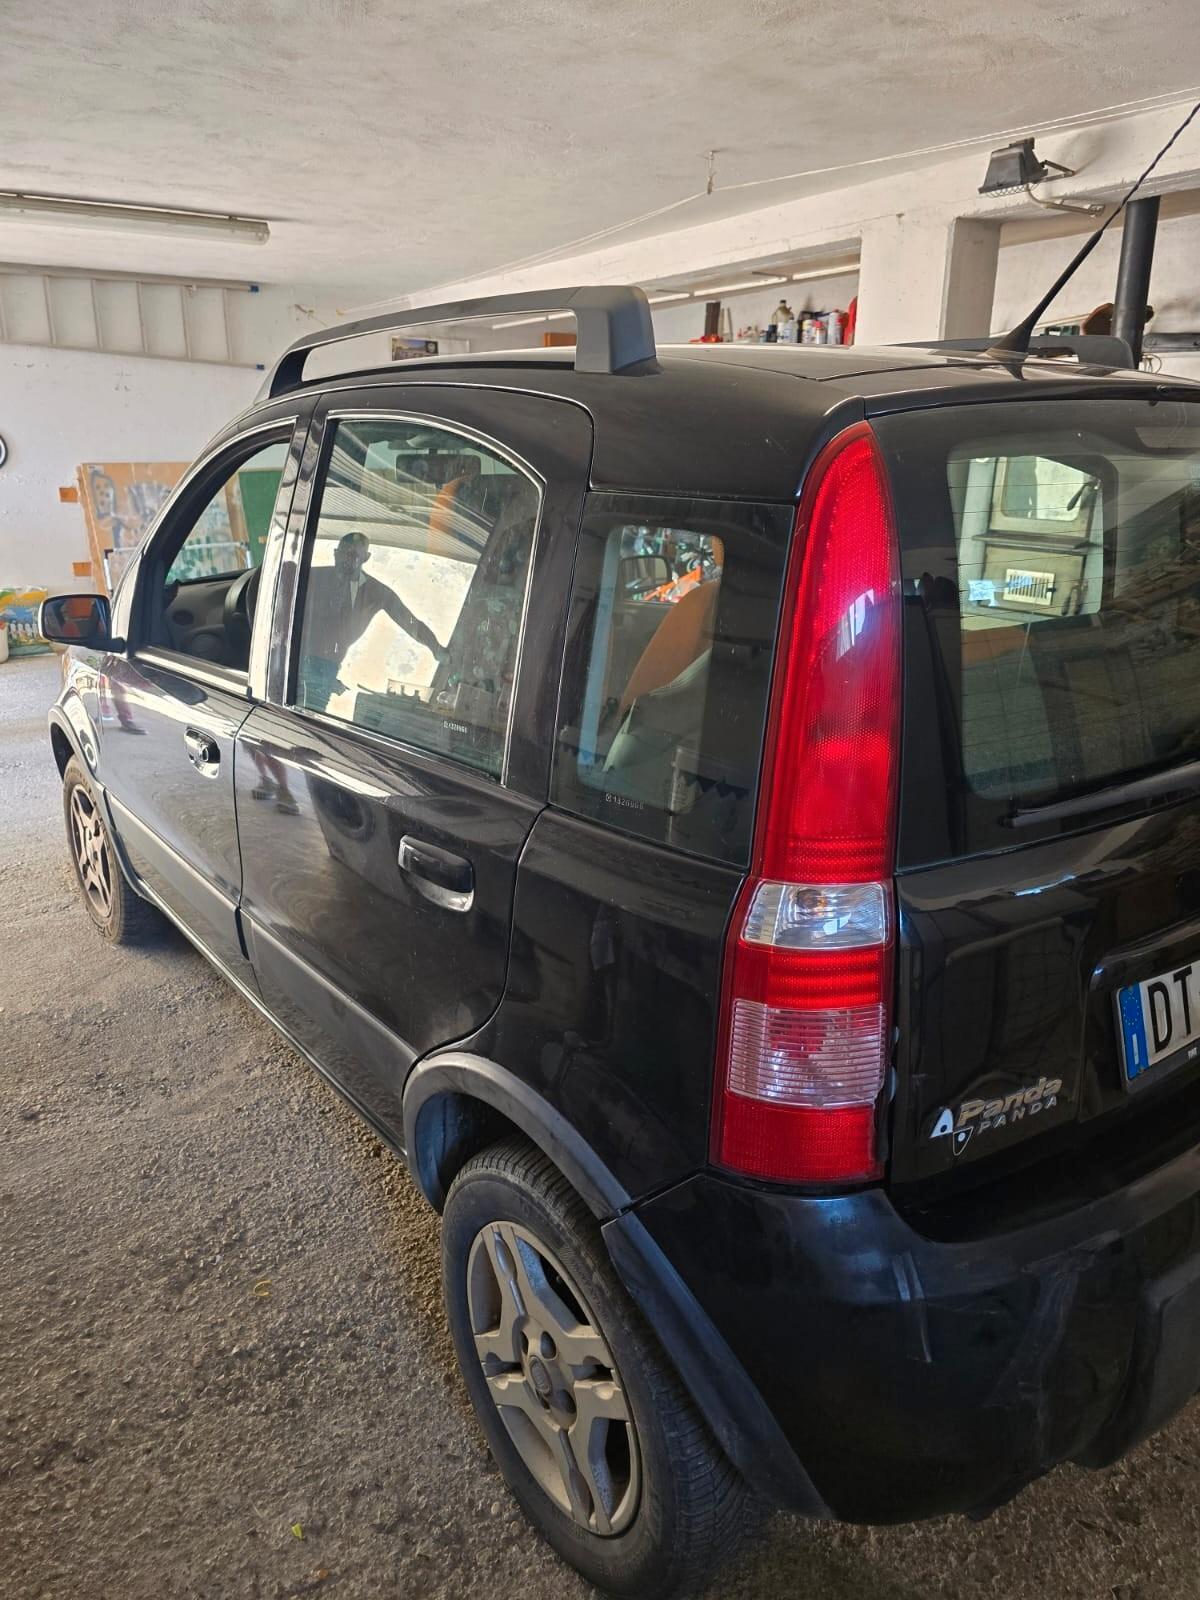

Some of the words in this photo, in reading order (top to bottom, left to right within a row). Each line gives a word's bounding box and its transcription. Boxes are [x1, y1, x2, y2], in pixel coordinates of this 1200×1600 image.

[1147, 965, 1193, 1054] DT
[1132, 1033, 1140, 1065] I
[957, 1077, 1063, 1127] Panda
[978, 1095, 1058, 1135] PANDA
